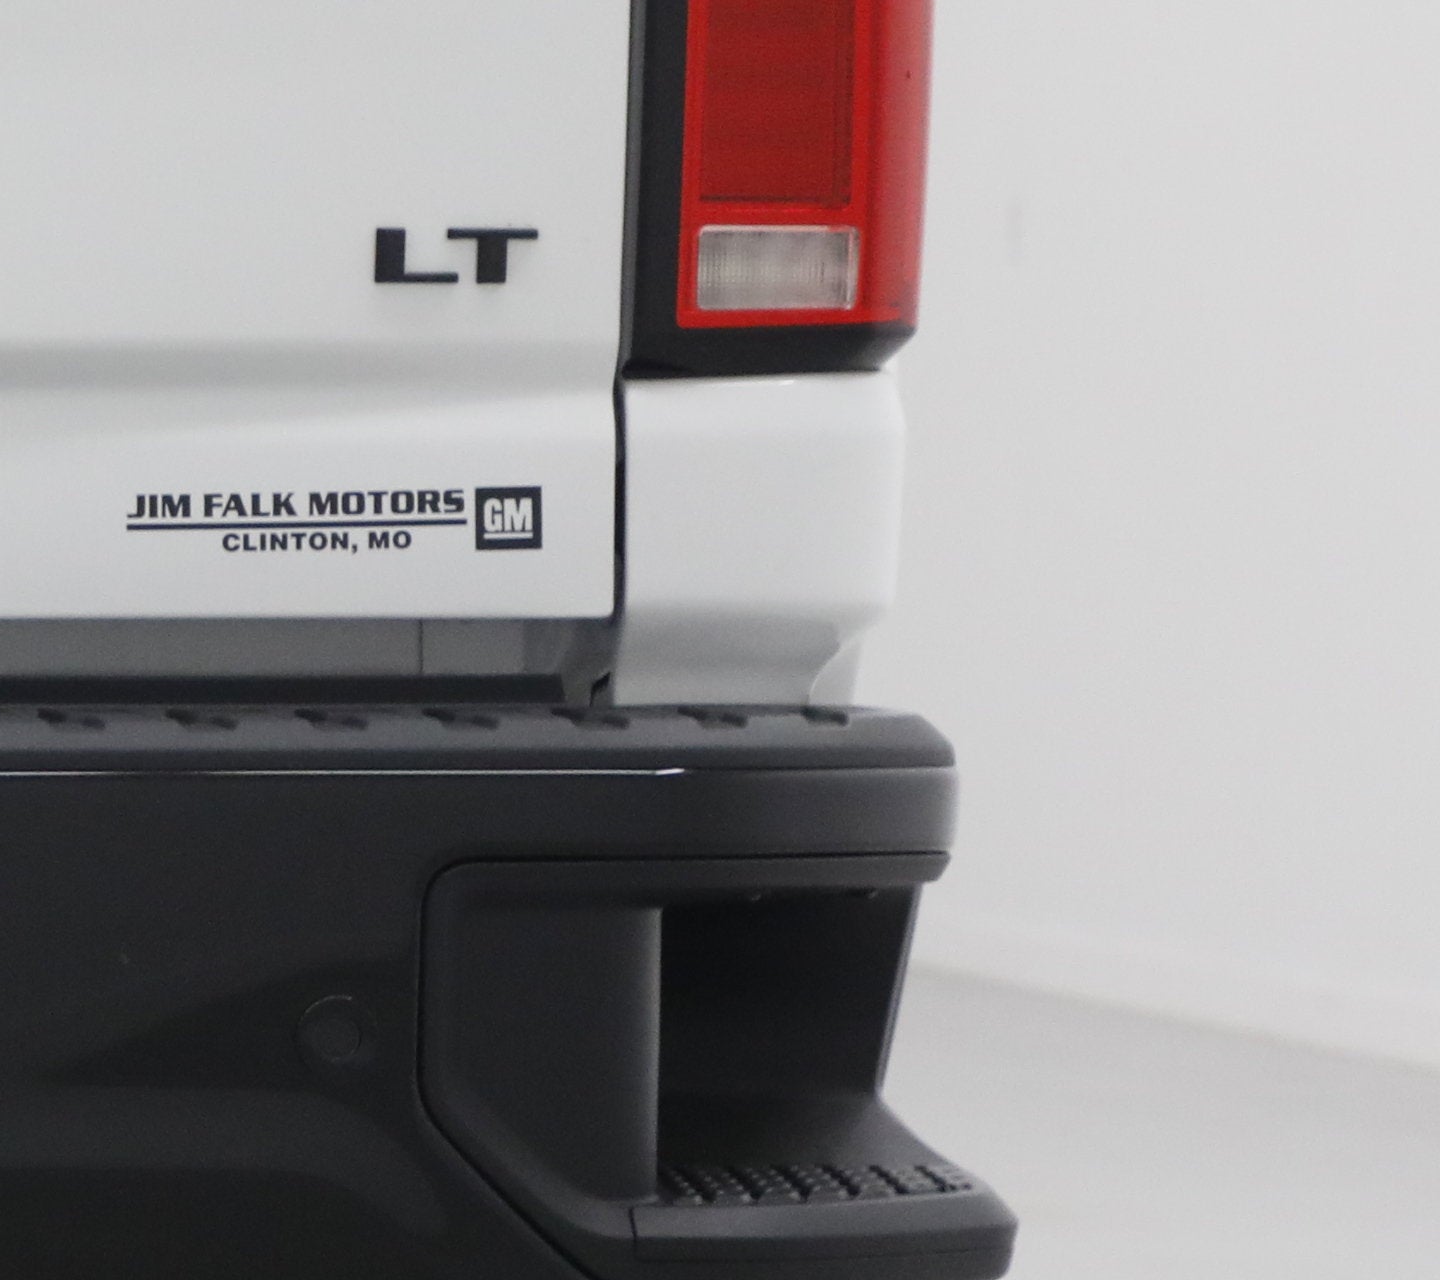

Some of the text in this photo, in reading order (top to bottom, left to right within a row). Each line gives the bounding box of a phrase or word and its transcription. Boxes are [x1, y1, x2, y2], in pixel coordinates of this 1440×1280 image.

[374, 227, 539, 284] LT
[127, 489, 465, 519] JIM FALK MOTORS
[483, 496, 533, 533] GM
[221, 530, 413, 554] CLINTON, MO
